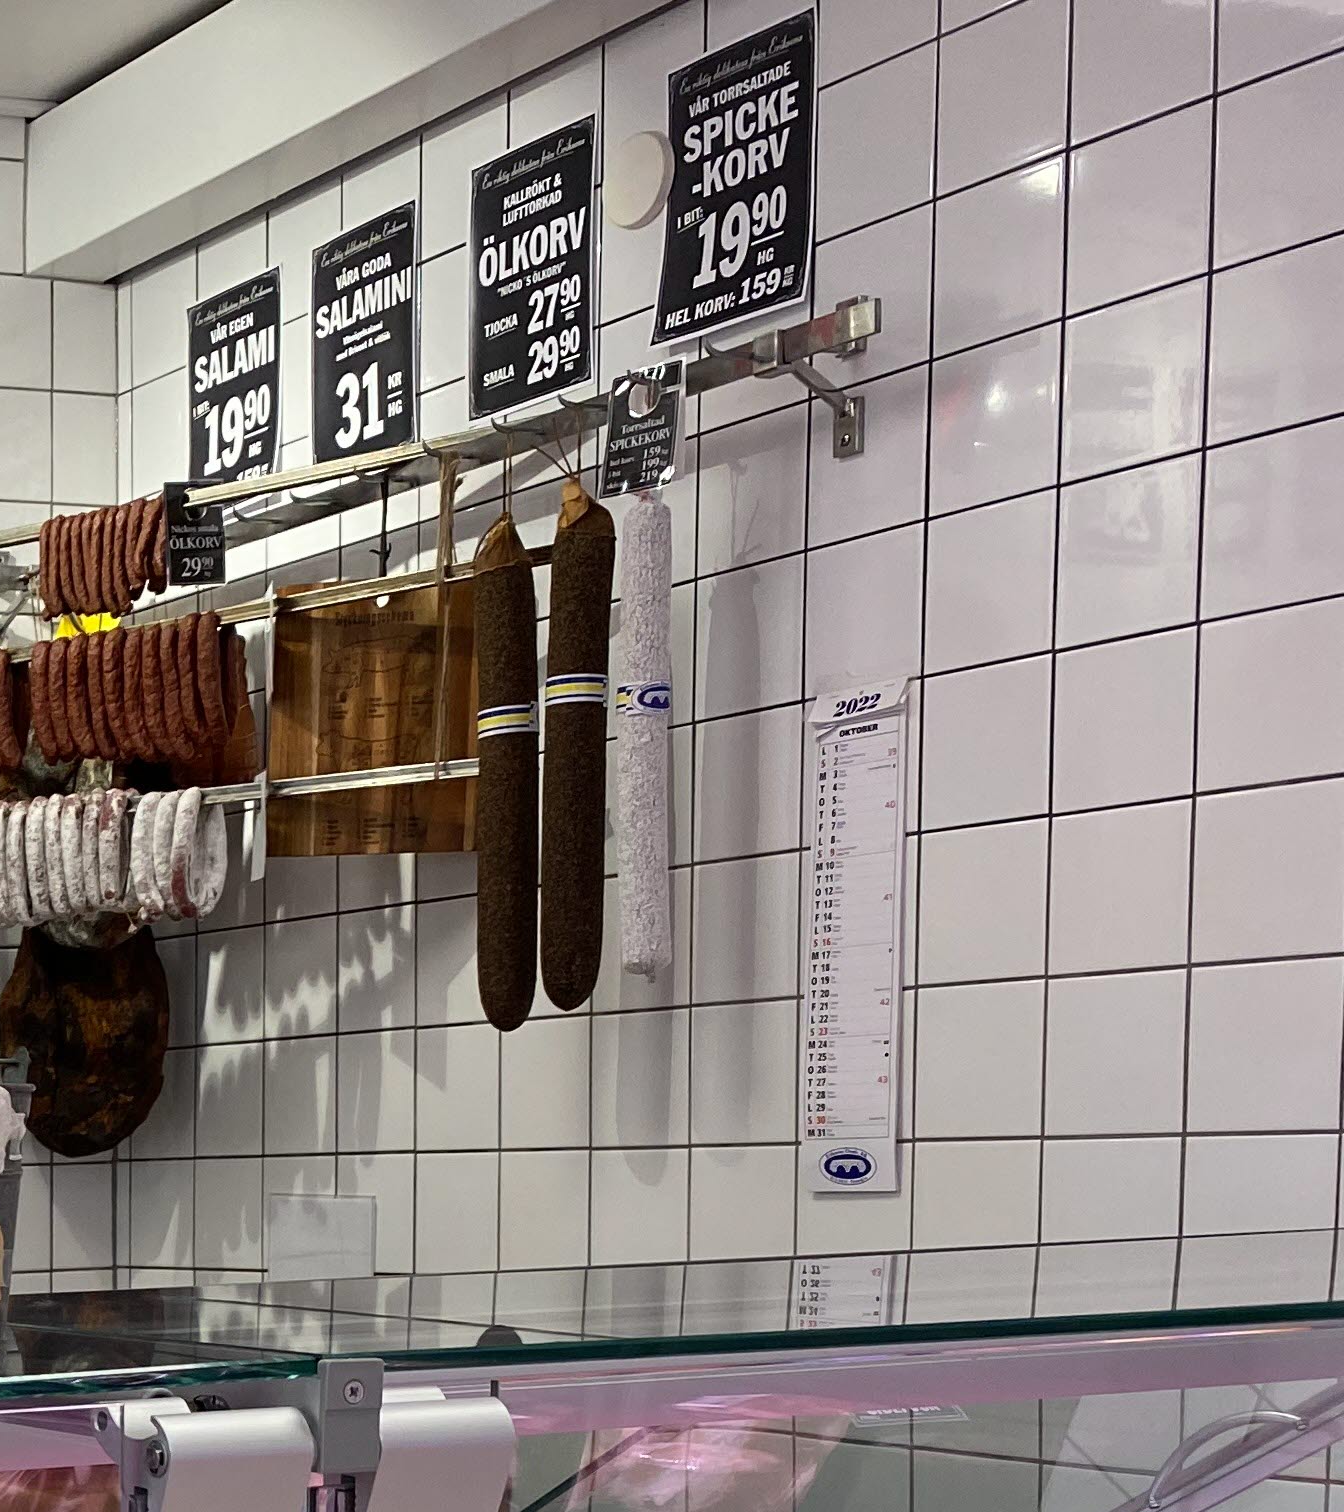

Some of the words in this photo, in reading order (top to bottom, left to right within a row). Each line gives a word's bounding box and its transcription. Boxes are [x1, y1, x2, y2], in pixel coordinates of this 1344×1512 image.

[689, 91, 710, 118] VÅR
[712, 61, 792, 105] TORRSALTADE
[683, 81, 800, 165] SPICKE
[691, 127, 791, 200] -KORV
[502, 189, 563, 227] LUFTTORKAD
[503, 178, 551, 207] KALLRÖKT
[478, 206, 587, 288] ÖLKORV
[336, 266, 360, 291] VÅRA
[362, 252, 392, 278] GODA
[315, 265, 412, 339] SALAMINI
[664, 306, 692, 330] HEL
[694, 292, 736, 322] KORV:
[738, 266, 782, 305] 159
[210, 320, 228, 345] VÅR
[229, 312, 254, 339] EGEN
[484, 313, 518, 338] TJOCKA
[194, 324, 276, 394] SALAMI
[483, 364, 515, 387] SMALA
[334, 361, 384, 449] 31
[609, 426, 673, 452] SPICKEKORV
[620, 415, 666, 436] Torrsaltad
[169, 534, 223, 550] ÖLKORV
[833, 692, 881, 718] 2022
[838, 723, 879, 738] OKTOBER
